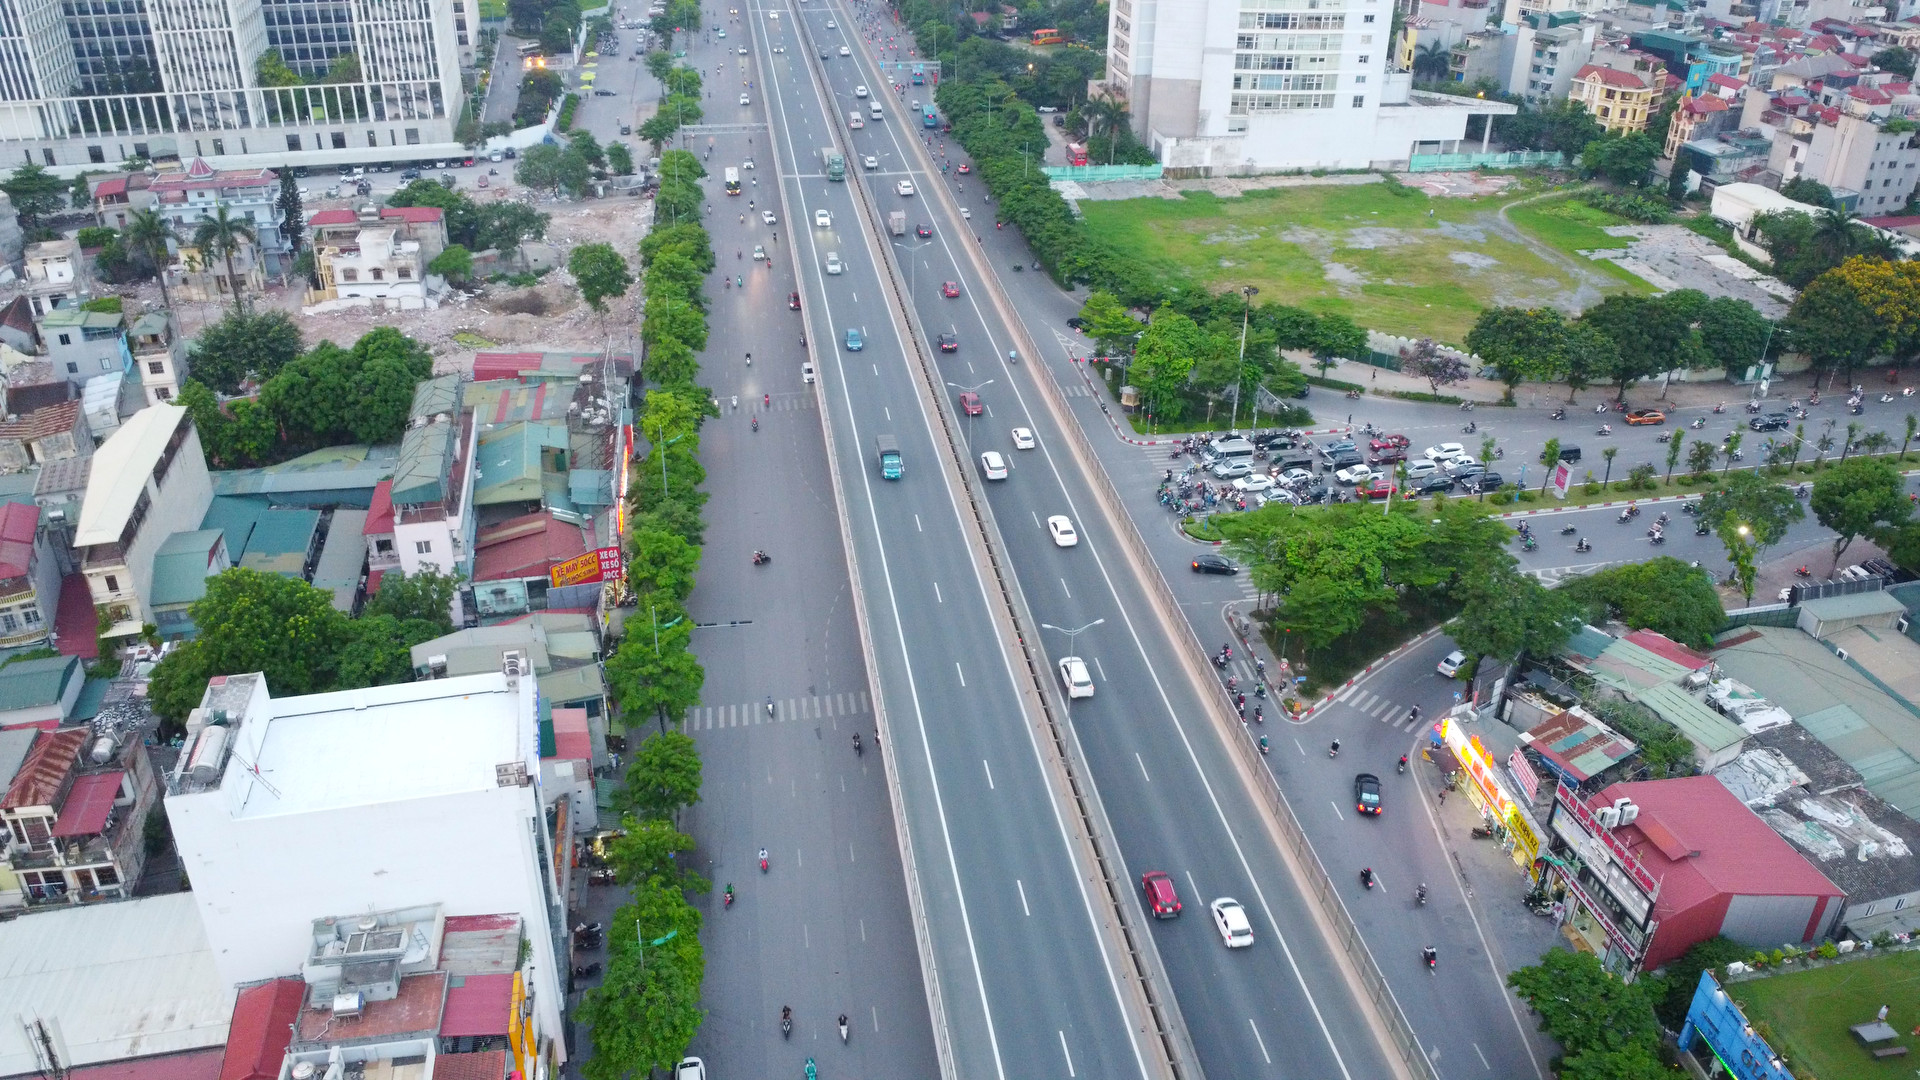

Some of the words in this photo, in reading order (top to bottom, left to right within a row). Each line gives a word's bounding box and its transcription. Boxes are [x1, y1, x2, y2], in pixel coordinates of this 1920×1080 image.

[599, 551, 608, 559] XE
[608, 549, 619, 558] GA
[556, 566, 564, 578] XE
[580, 555, 596, 568] 50CC
[601, 560, 610, 570] XE
[610, 557, 620, 568] SỐ
[603, 570, 620, 579] 50CC
